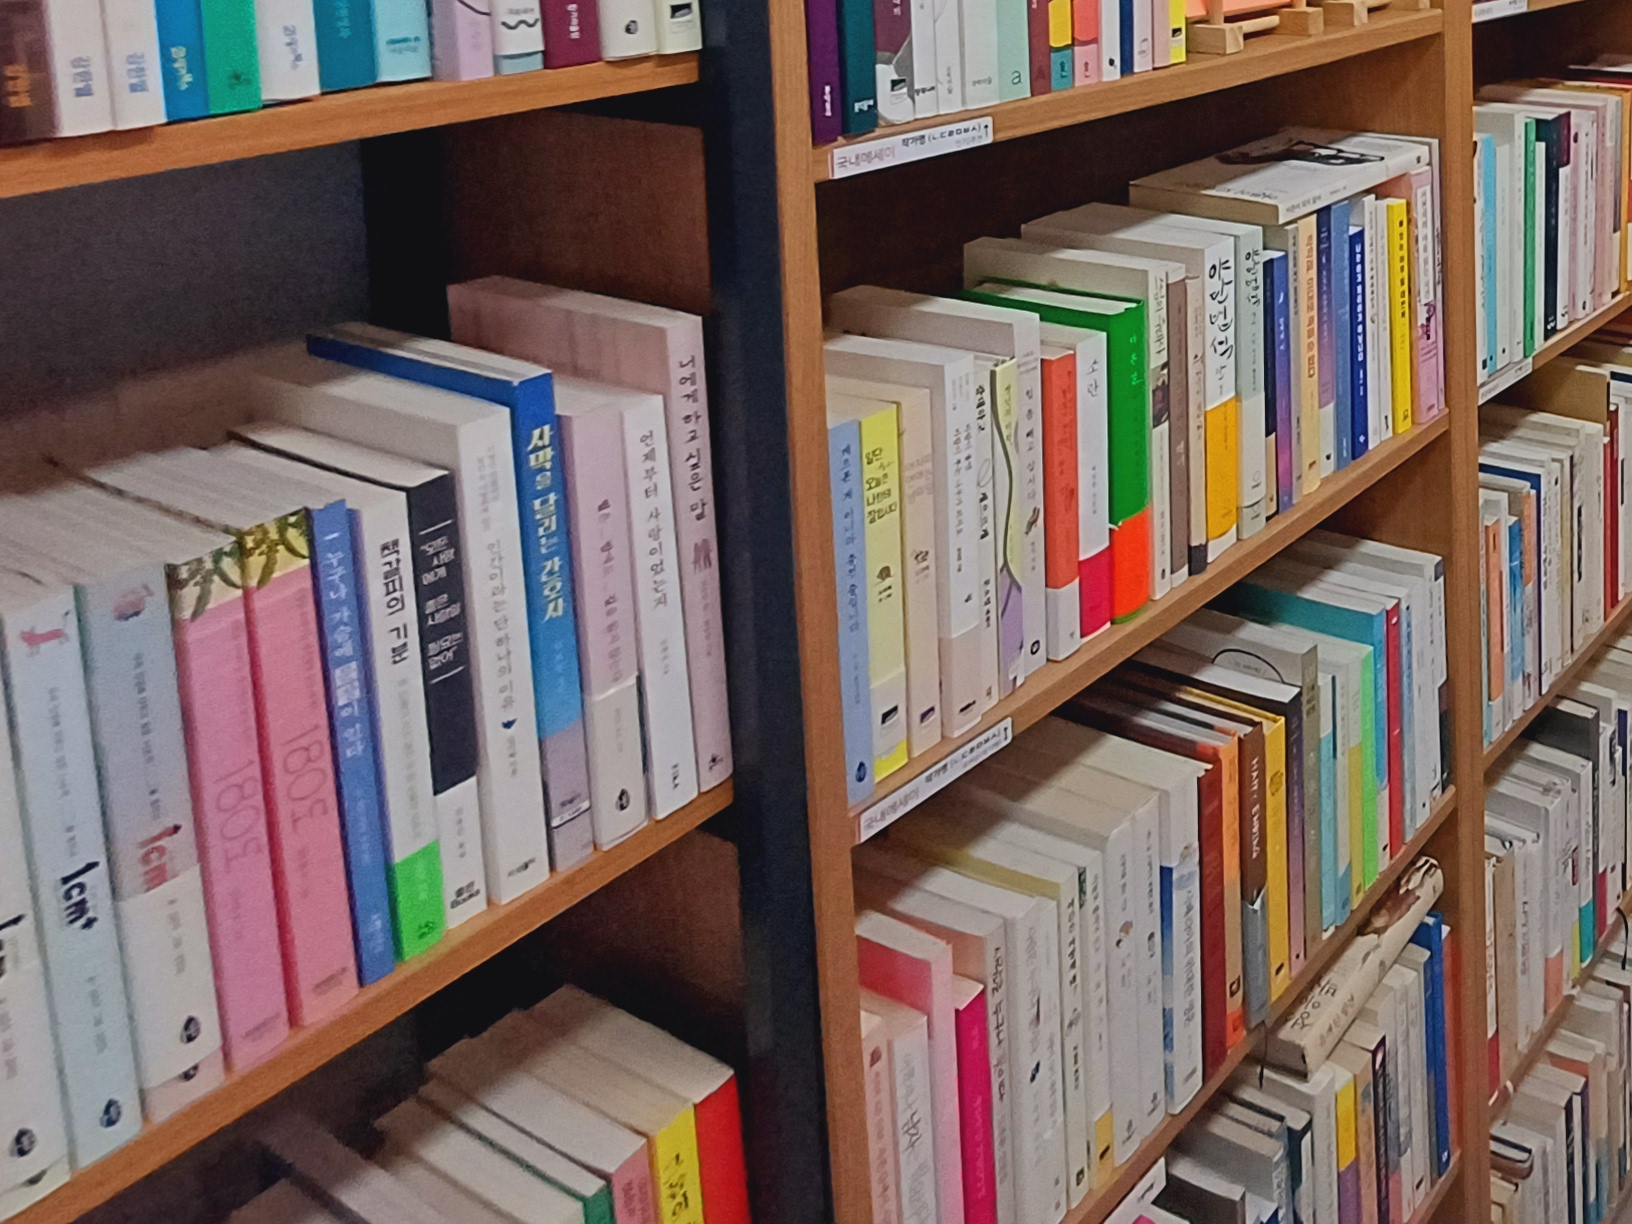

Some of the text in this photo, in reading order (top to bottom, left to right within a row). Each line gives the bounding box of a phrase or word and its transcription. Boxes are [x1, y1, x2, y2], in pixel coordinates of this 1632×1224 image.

[836, 144, 896, 170] 국내에세이
[902, 133, 926, 148] 작가명
[1085, 358, 1100, 398] 소란
[677, 355, 707, 522] 너에게 하고 싶은 말
[864, 446, 883, 465] 일단
[864, 472, 889, 491] 오늘은
[526, 422, 566, 624] 사막을 달리는 간호사
[638, 428, 670, 610] 언제부터 사랑이었는지
[866, 502, 898, 525] 잘합시다
[379, 537, 411, 665] 책갈피의 기분
